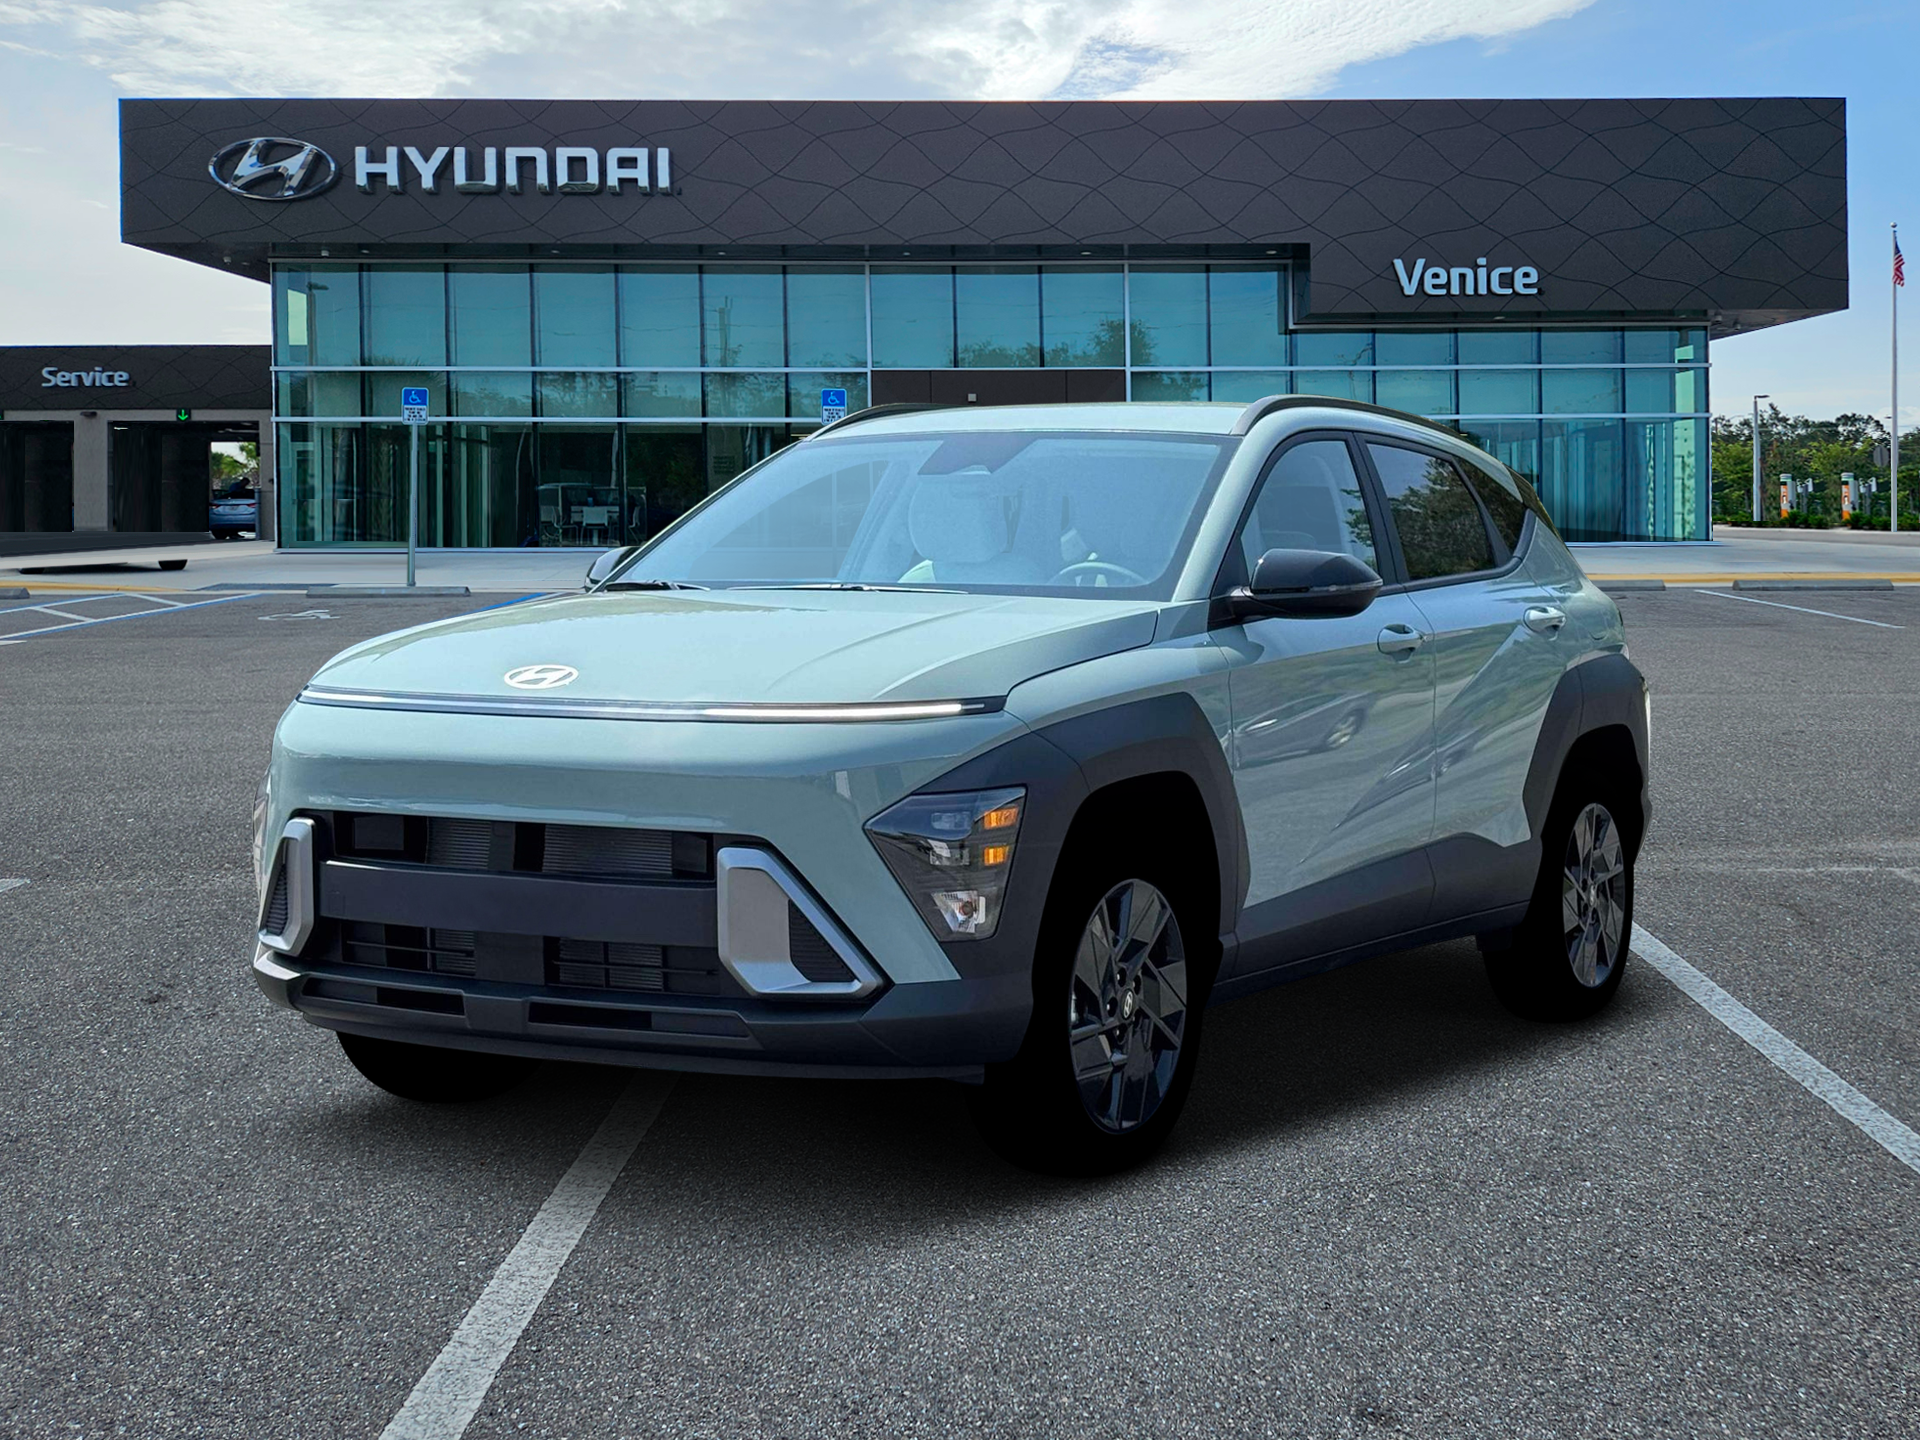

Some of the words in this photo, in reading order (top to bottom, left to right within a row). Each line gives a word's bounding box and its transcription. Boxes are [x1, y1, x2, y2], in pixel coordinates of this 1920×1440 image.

[354, 146, 672, 194] HYUNDAI
[1393, 257, 1539, 296] Venice
[41, 367, 130, 388] Service
